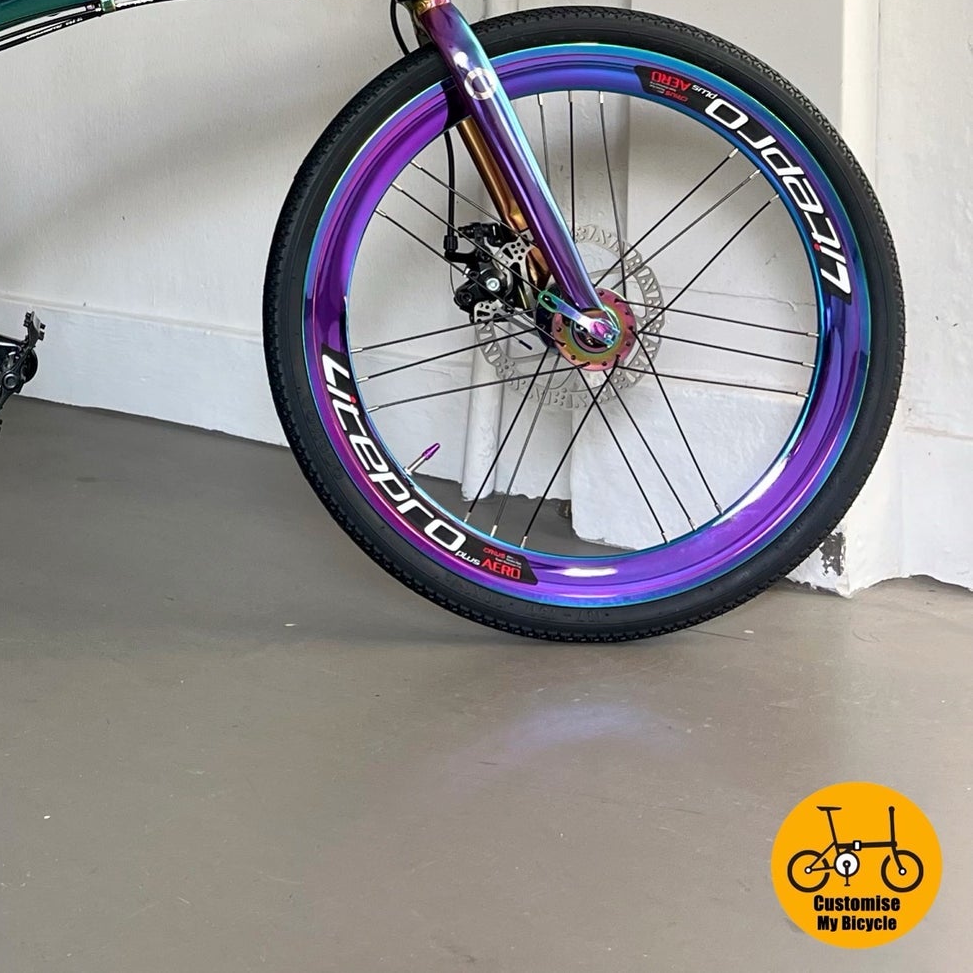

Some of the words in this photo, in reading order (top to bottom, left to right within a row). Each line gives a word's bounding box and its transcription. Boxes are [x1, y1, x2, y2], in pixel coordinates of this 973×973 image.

[651, 71, 692, 92] AERO
[691, 84, 719, 101] plus
[704, 98, 852, 294] Litepro
[321, 354, 467, 552] Litepro
[455, 549, 481, 567] plus
[481, 557, 522, 580] AERO
